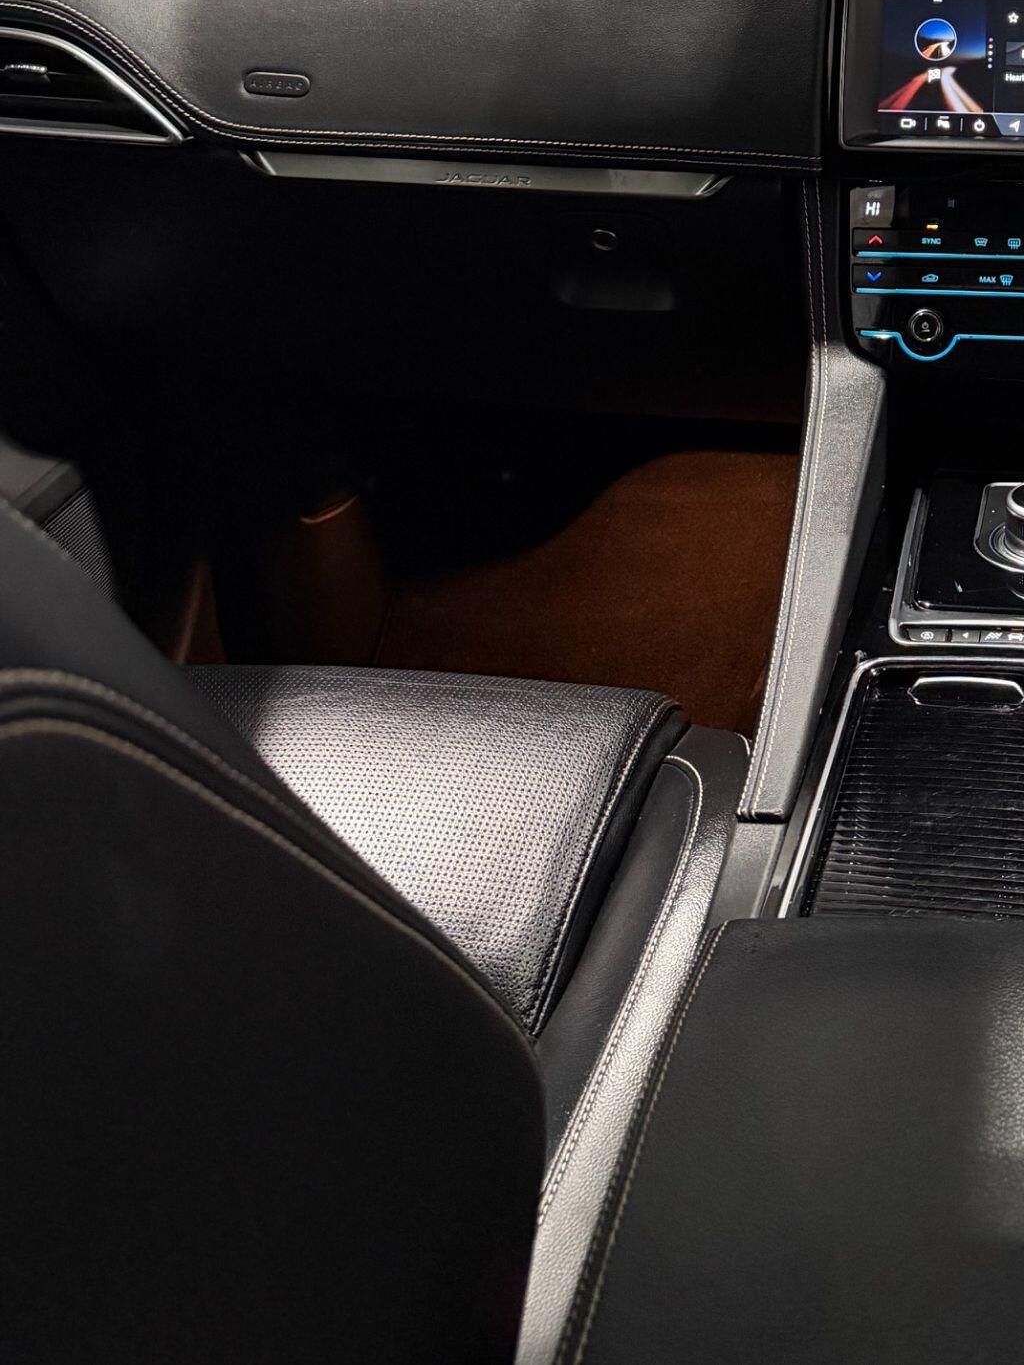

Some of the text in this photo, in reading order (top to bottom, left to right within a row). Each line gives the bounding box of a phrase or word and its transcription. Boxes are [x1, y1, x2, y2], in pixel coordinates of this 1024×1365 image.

[435, 172, 533, 188] JAGUAR
[865, 201, 880, 216] HI
[921, 237, 942, 245] SYNC
[978, 275, 997, 284] MAX
